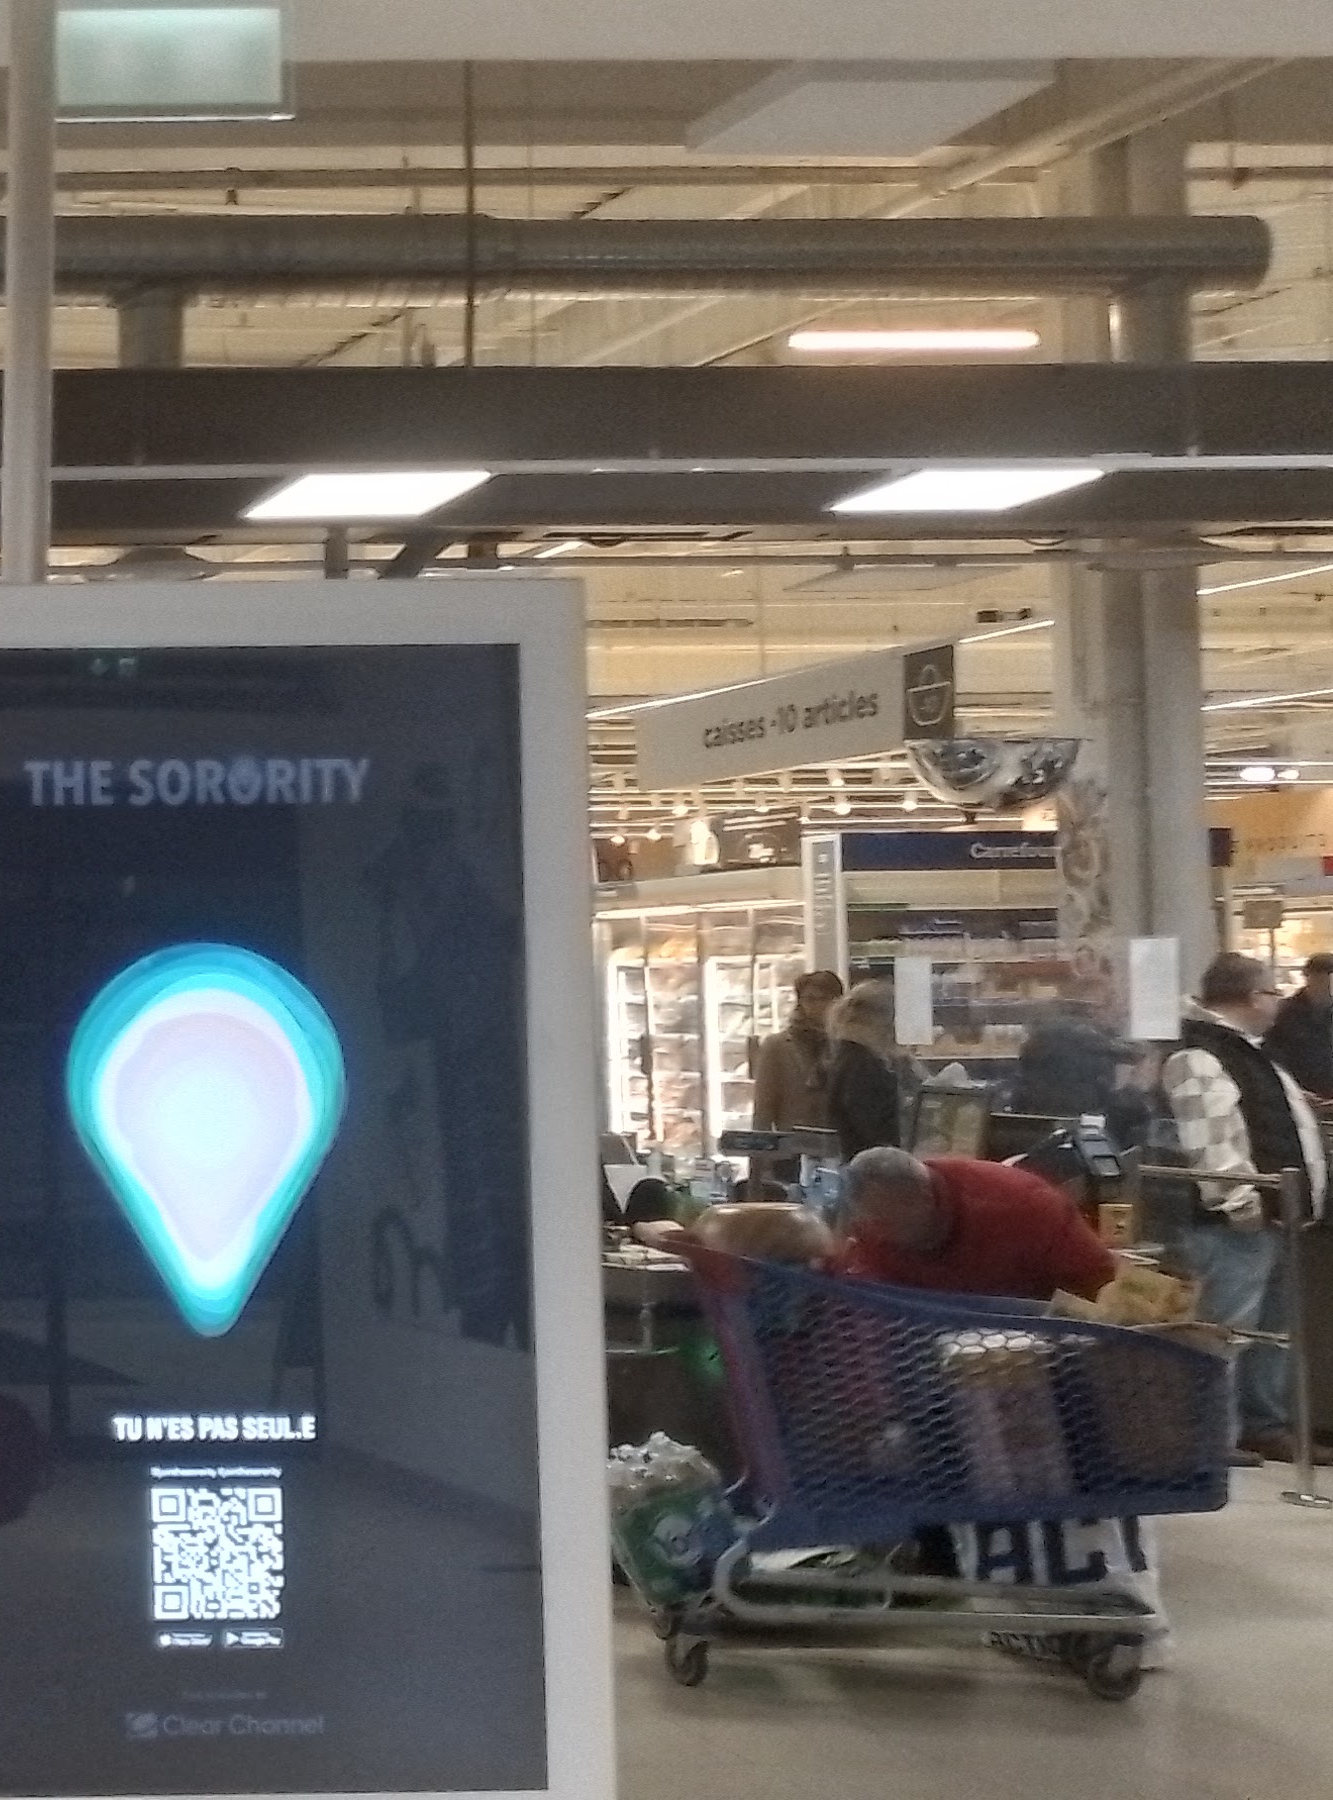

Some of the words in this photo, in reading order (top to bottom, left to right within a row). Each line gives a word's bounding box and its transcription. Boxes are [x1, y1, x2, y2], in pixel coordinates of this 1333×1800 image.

[703, 715, 765, 748] caisses
[801, 690, 879, 730] articles
[23, 760, 114, 806] THE
[128, 755, 370, 805] SORORITY
[112, 1416, 143, 1441] TU
[145, 1416, 195, 1441] N'ES
[198, 1416, 239, 1440] PAS
[242, 1415, 317, 1440] SEUL.E
[163, 1714, 223, 1734] Clear
[229, 1714, 325, 1734] Channel
